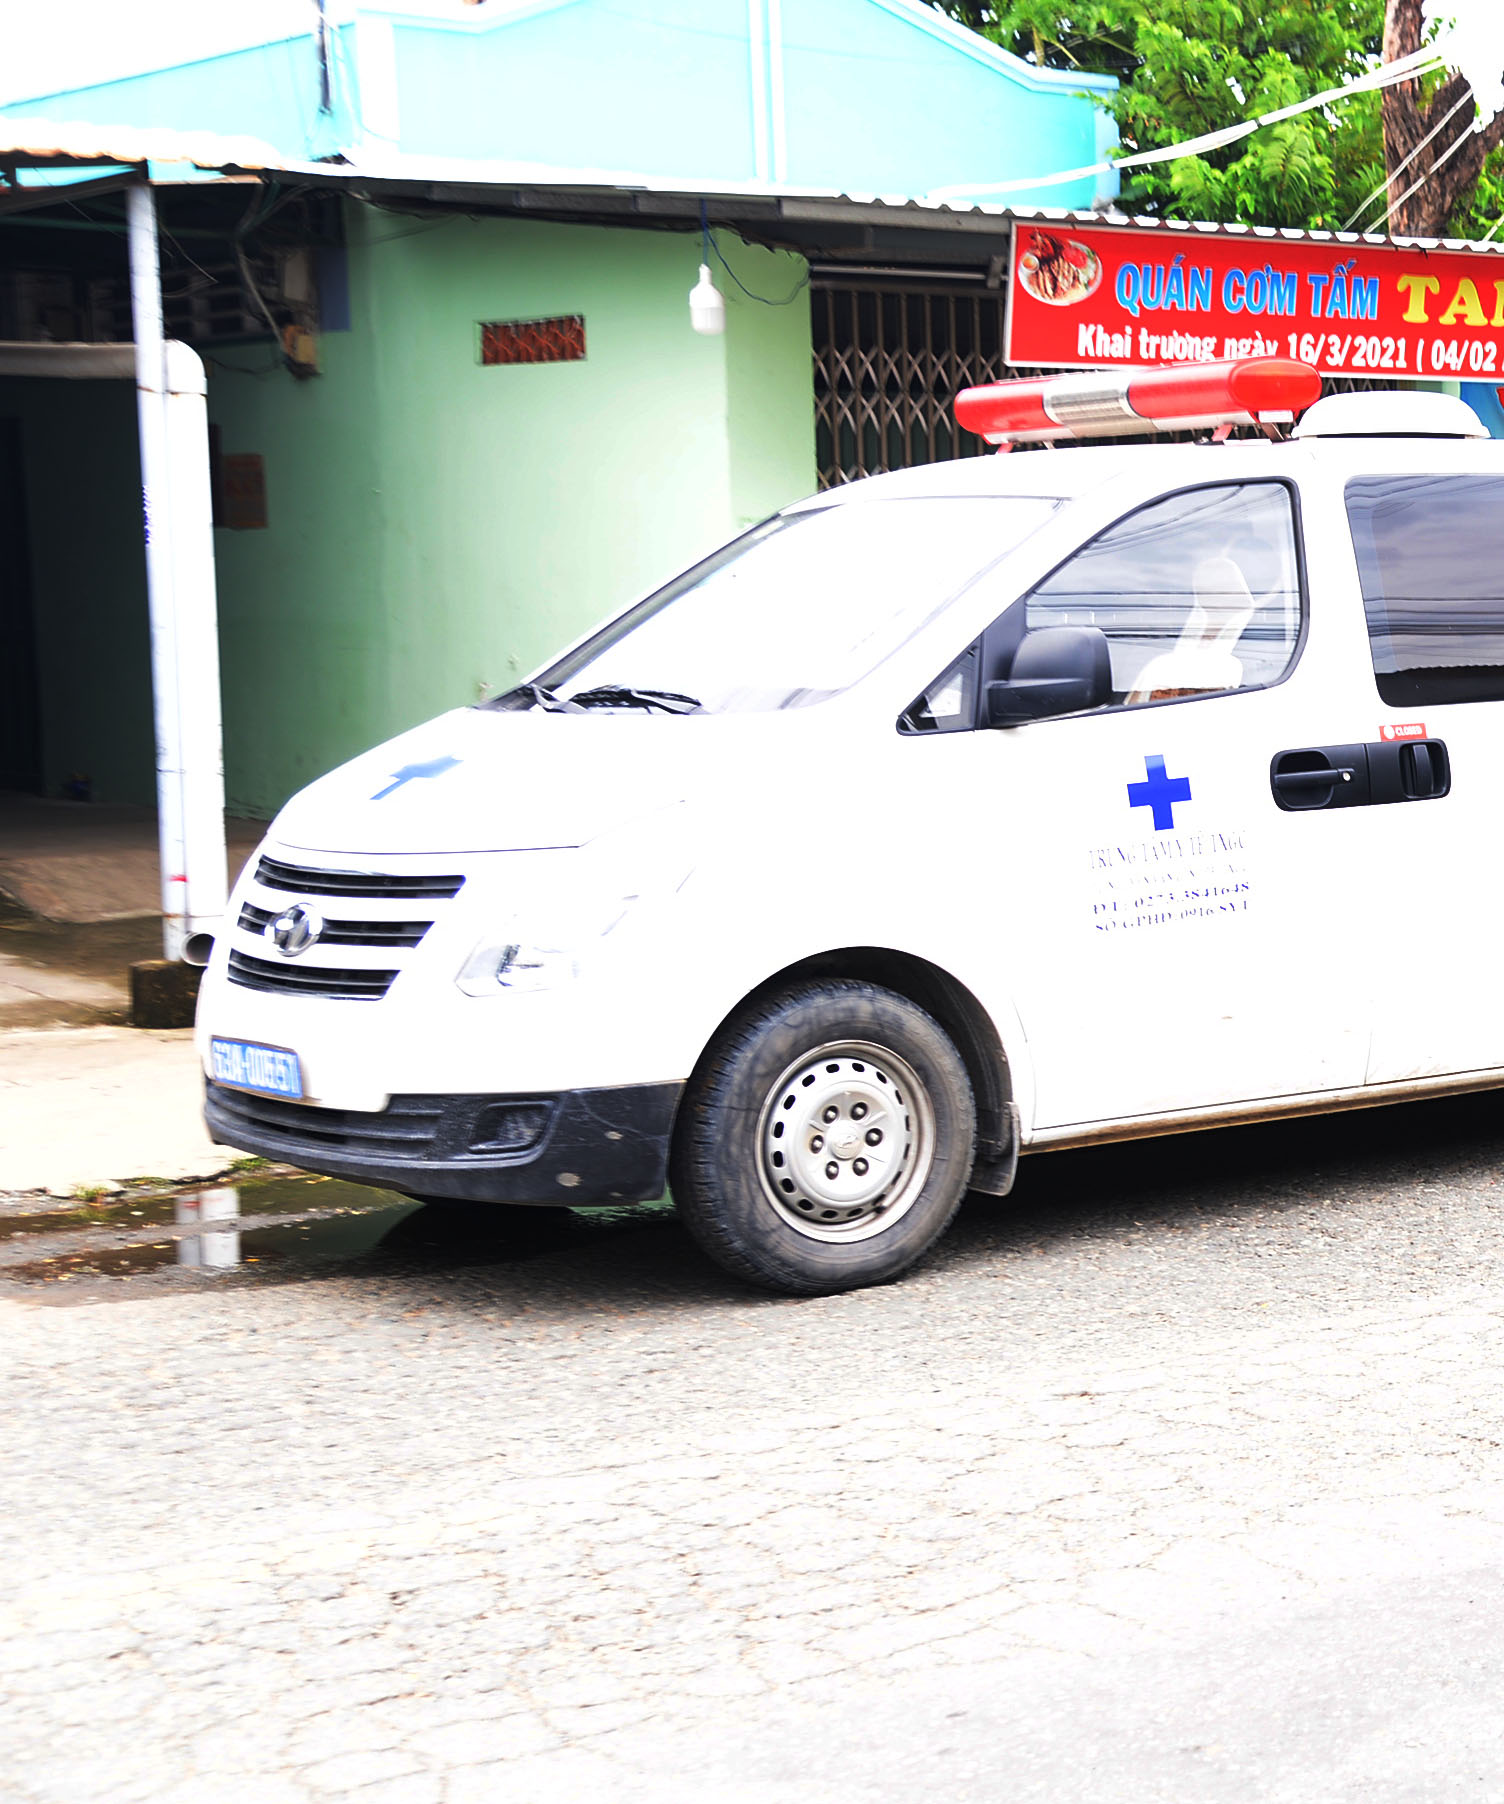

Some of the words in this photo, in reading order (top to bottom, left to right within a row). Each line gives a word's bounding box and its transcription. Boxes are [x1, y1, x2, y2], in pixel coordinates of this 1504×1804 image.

[1115, 254, 1213, 317] QUÁN
[1222, 264, 1298, 316] CƠM
[1307, 258, 1380, 320] TẤM
[1077, 323, 1133, 358] Khai
[1138, 326, 1217, 361] trường
[1287, 332, 1408, 368] 16/3/2021
[1430, 338, 1498, 372] 04/02
